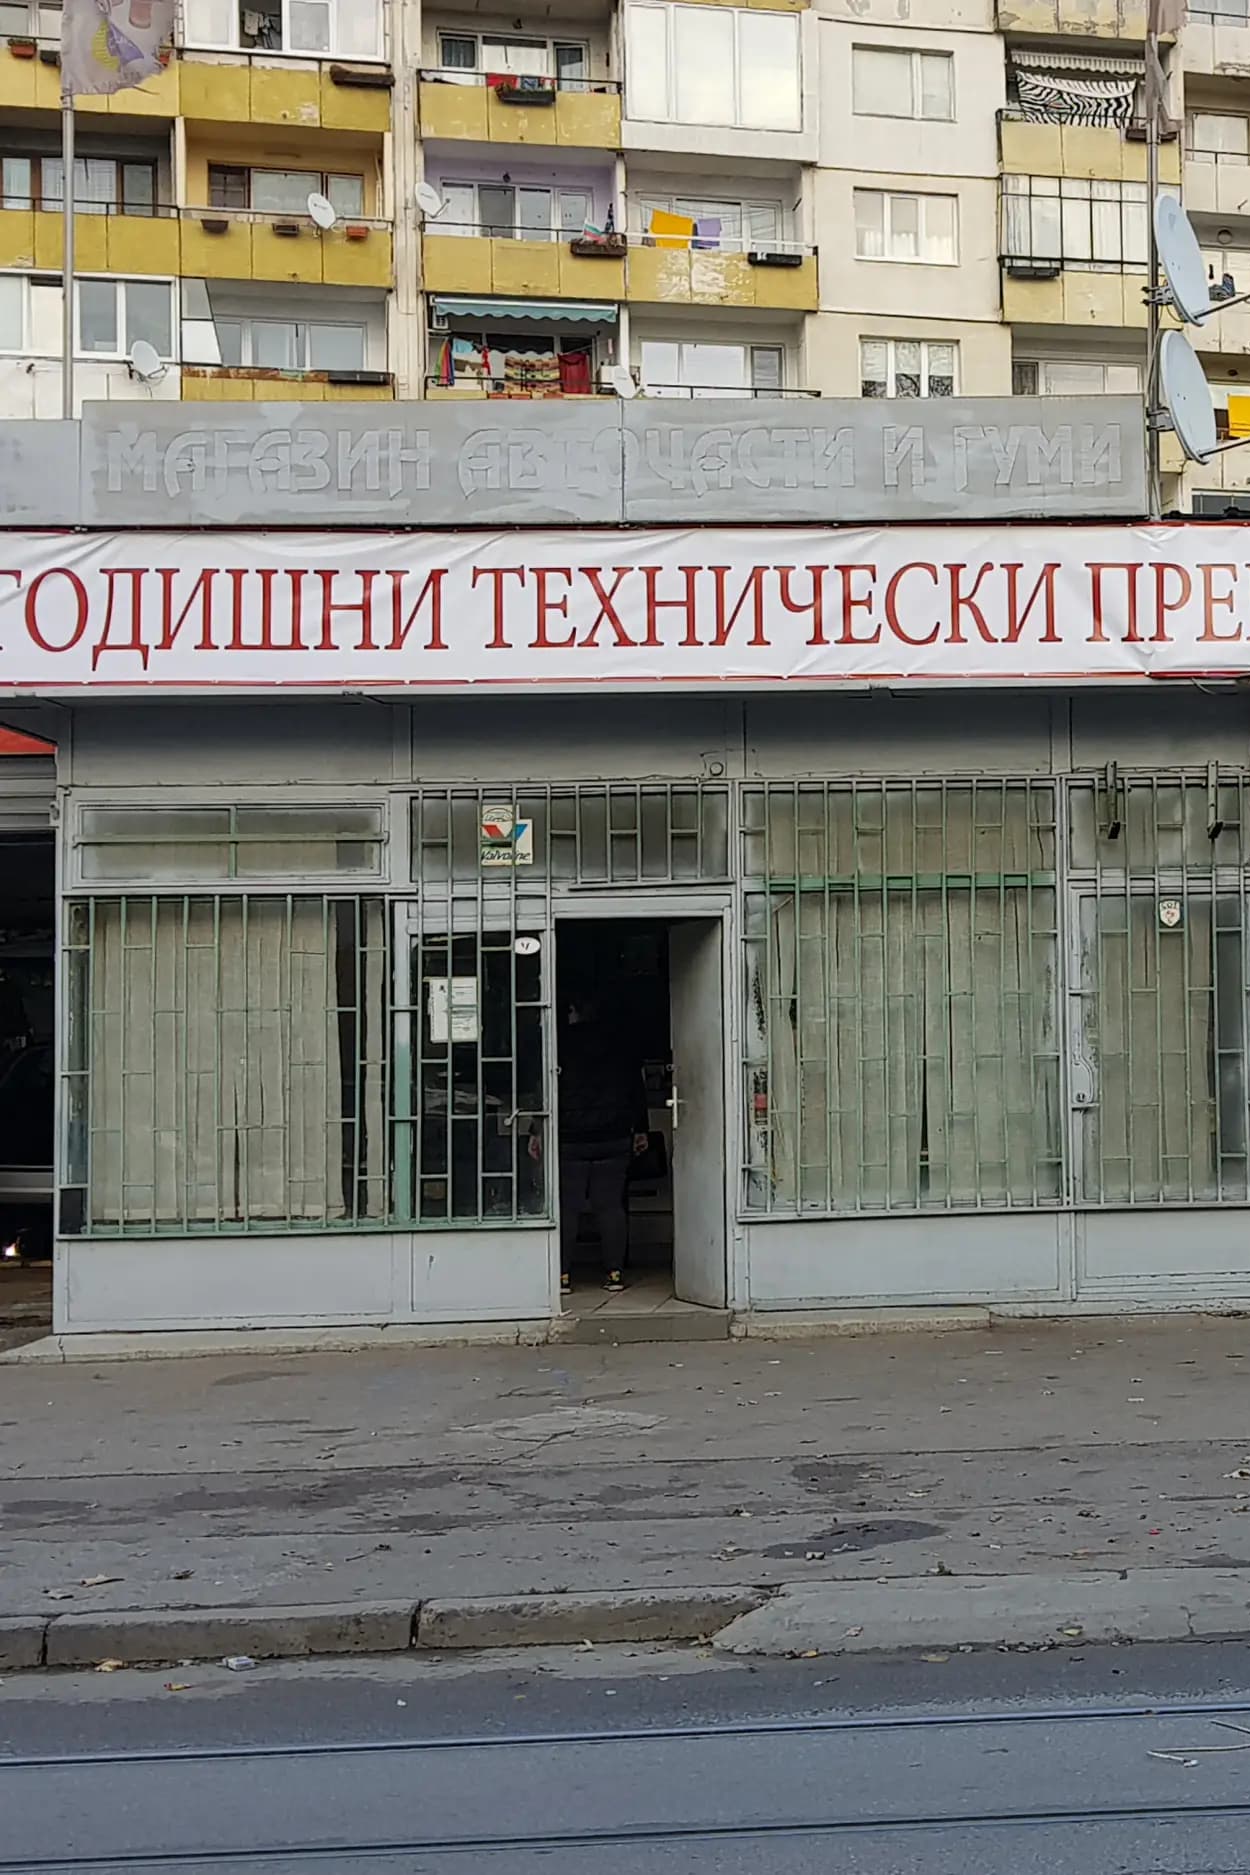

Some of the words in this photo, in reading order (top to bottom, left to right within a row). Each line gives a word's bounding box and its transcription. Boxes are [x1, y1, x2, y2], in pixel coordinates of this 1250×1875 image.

[105, 427, 431, 499] МАГАЗИН
[883, 424, 926, 487] И
[952, 423, 1121, 492] ГУМИ
[472, 562, 1062, 649] ТЕХНИЧЕСКИ
